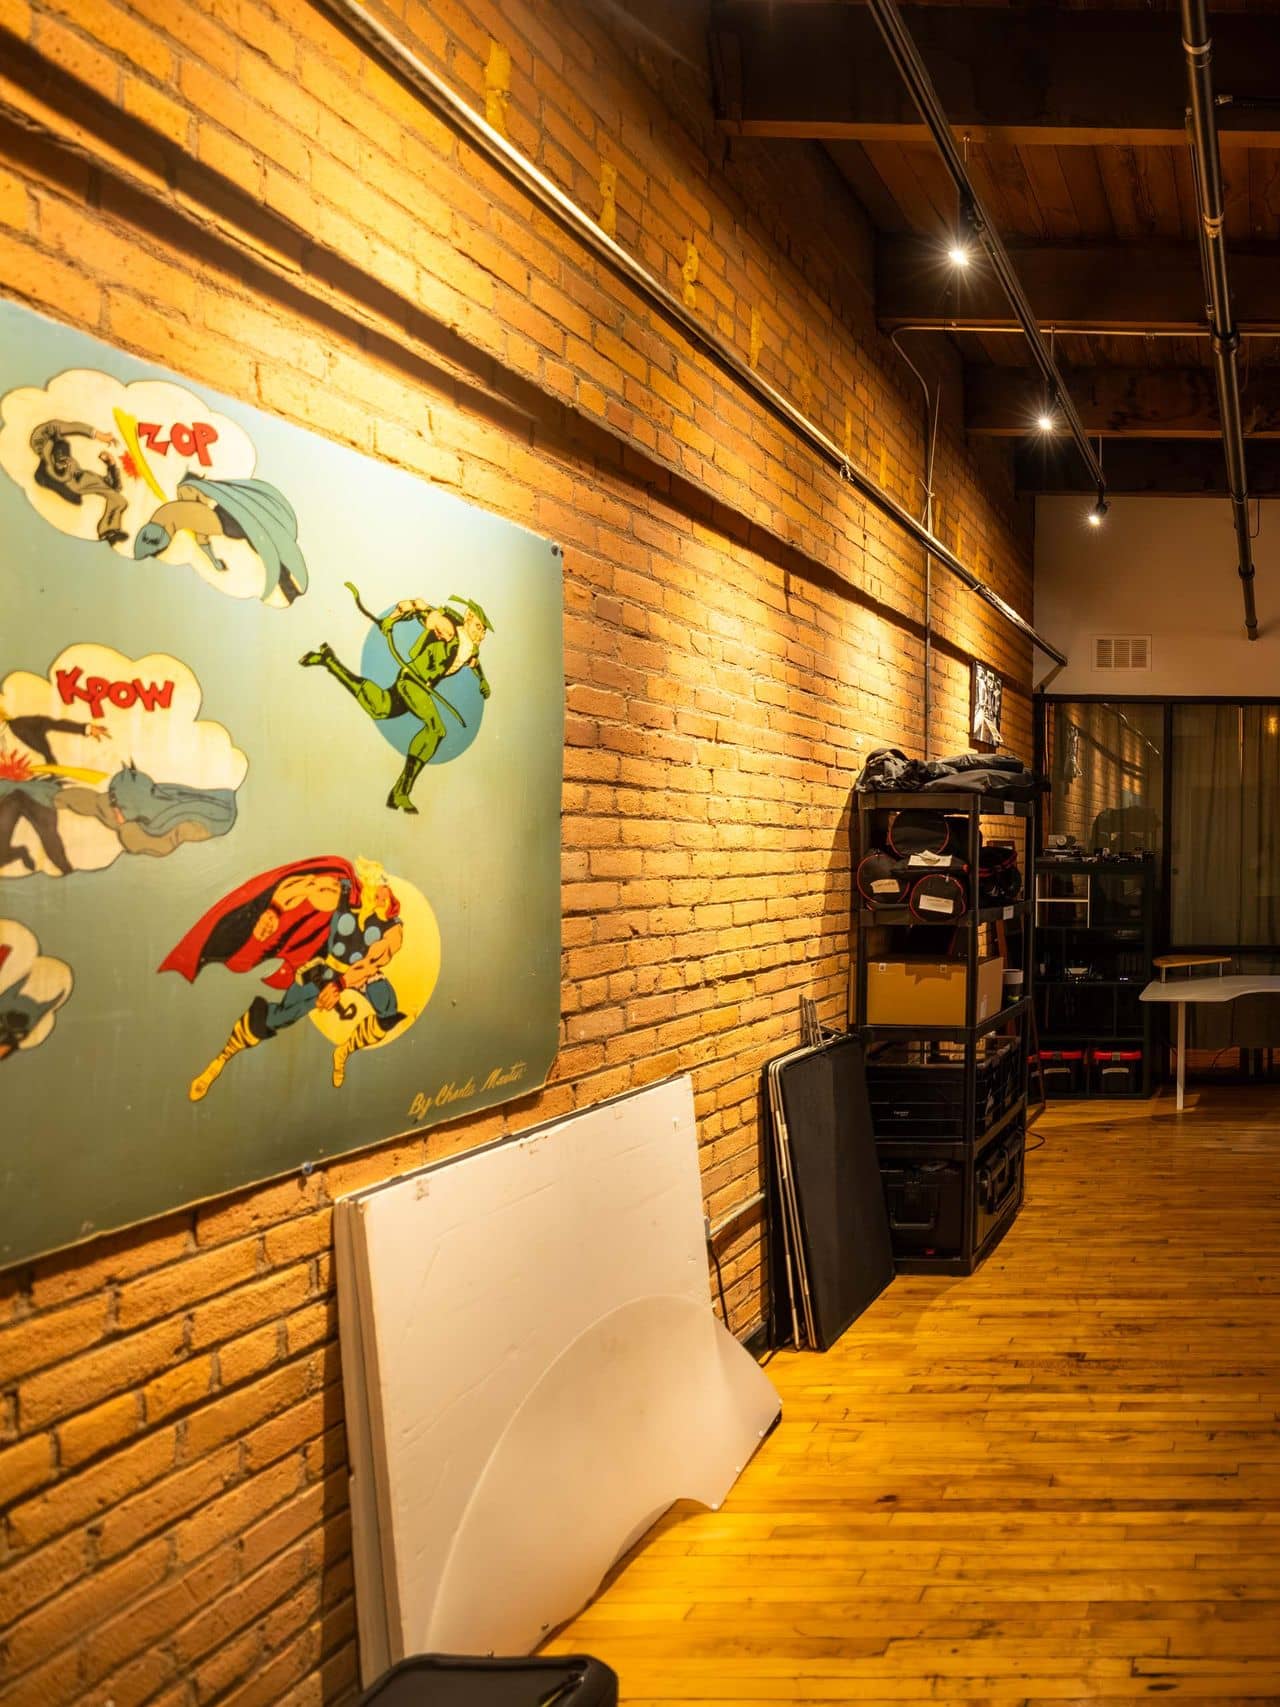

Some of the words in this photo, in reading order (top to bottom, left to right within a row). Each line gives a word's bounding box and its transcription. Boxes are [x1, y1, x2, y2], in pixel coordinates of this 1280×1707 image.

[137, 422, 219, 467] ZOP
[56, 666, 174, 719] KPOW
[407, 1091, 432, 1120] By
